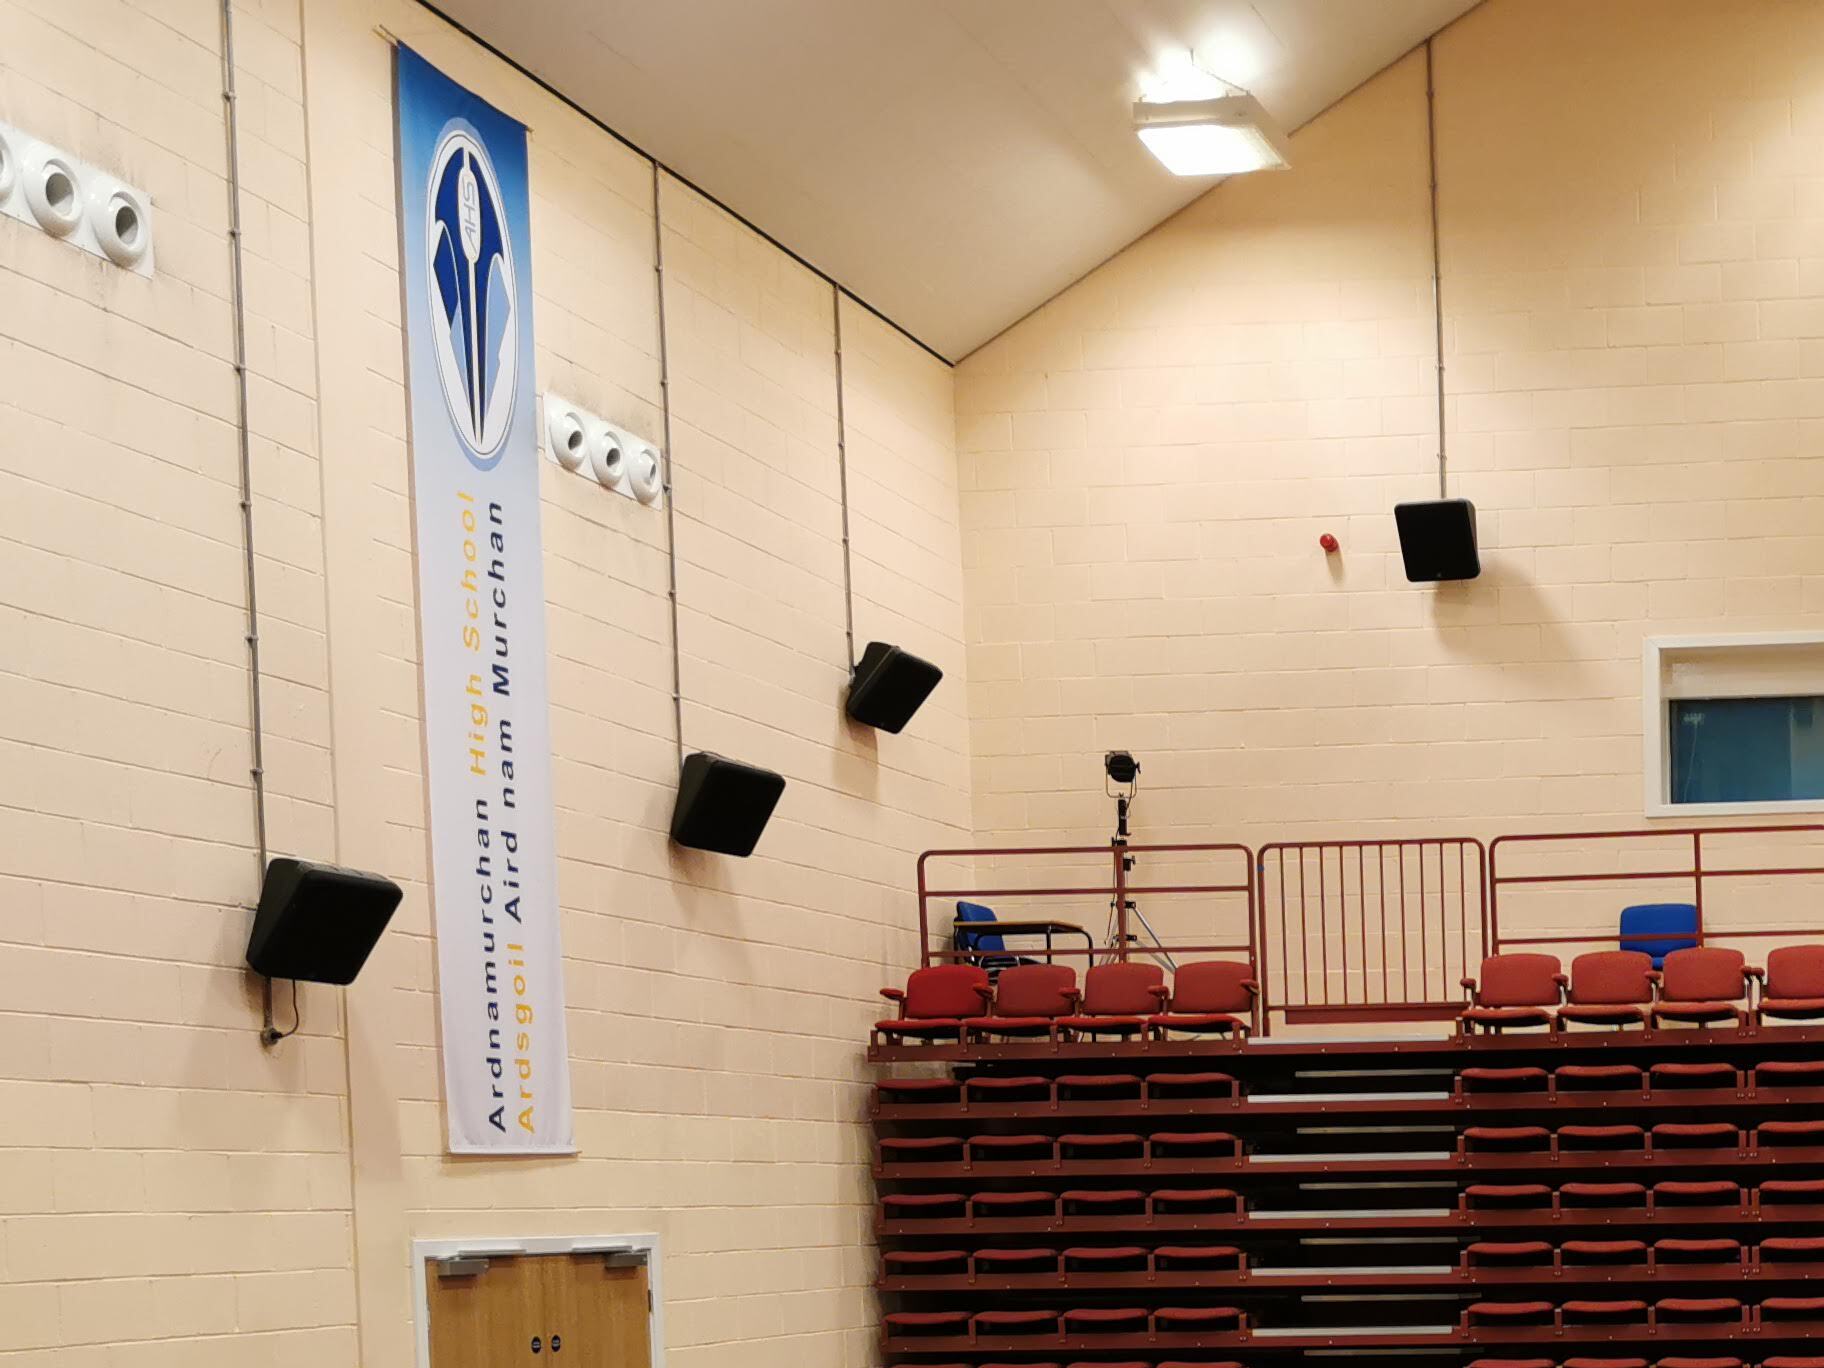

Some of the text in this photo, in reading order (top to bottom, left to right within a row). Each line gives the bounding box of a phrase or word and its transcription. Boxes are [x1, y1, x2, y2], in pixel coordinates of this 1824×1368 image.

[462, 176, 478, 255] AHS
[456, 490, 507, 1133] Ardnamurchan High School
[487, 501, 537, 1135] Ardsgoil Aird nam Murchan
